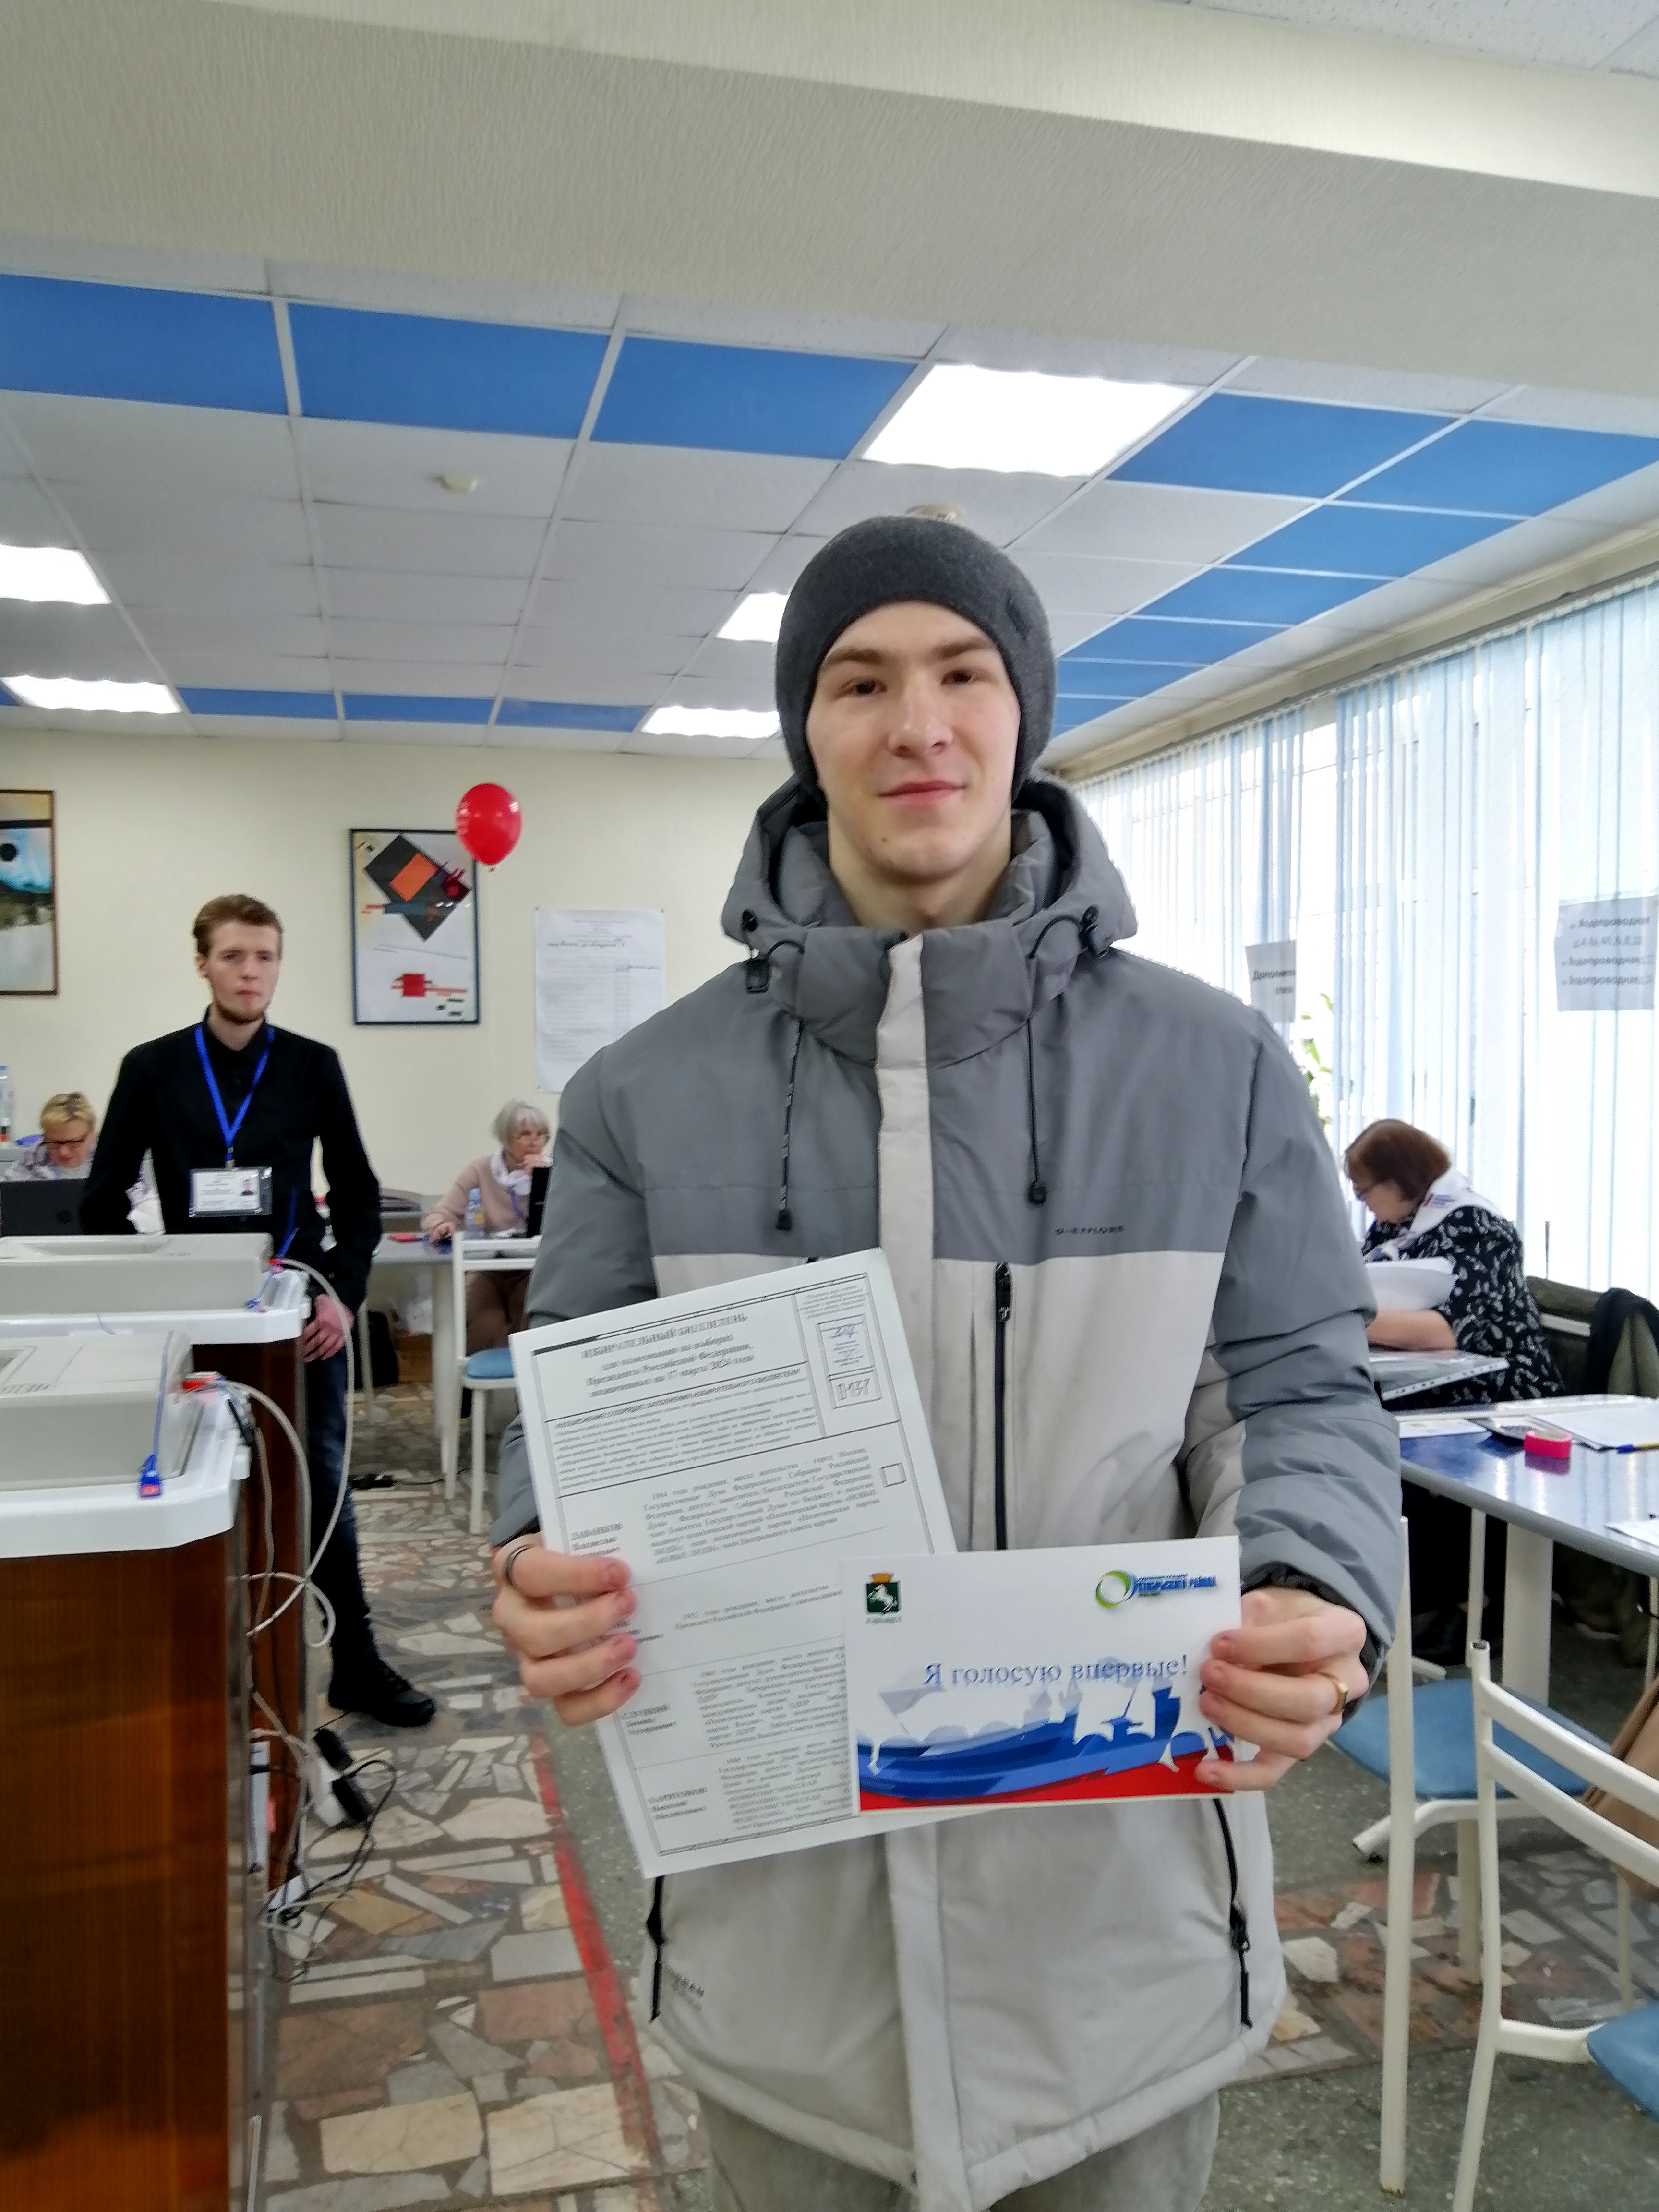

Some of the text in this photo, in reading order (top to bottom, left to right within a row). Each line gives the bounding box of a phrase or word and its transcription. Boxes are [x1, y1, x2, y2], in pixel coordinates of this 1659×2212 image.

[923, 1654, 1188, 1687] Я голосую впервые!
